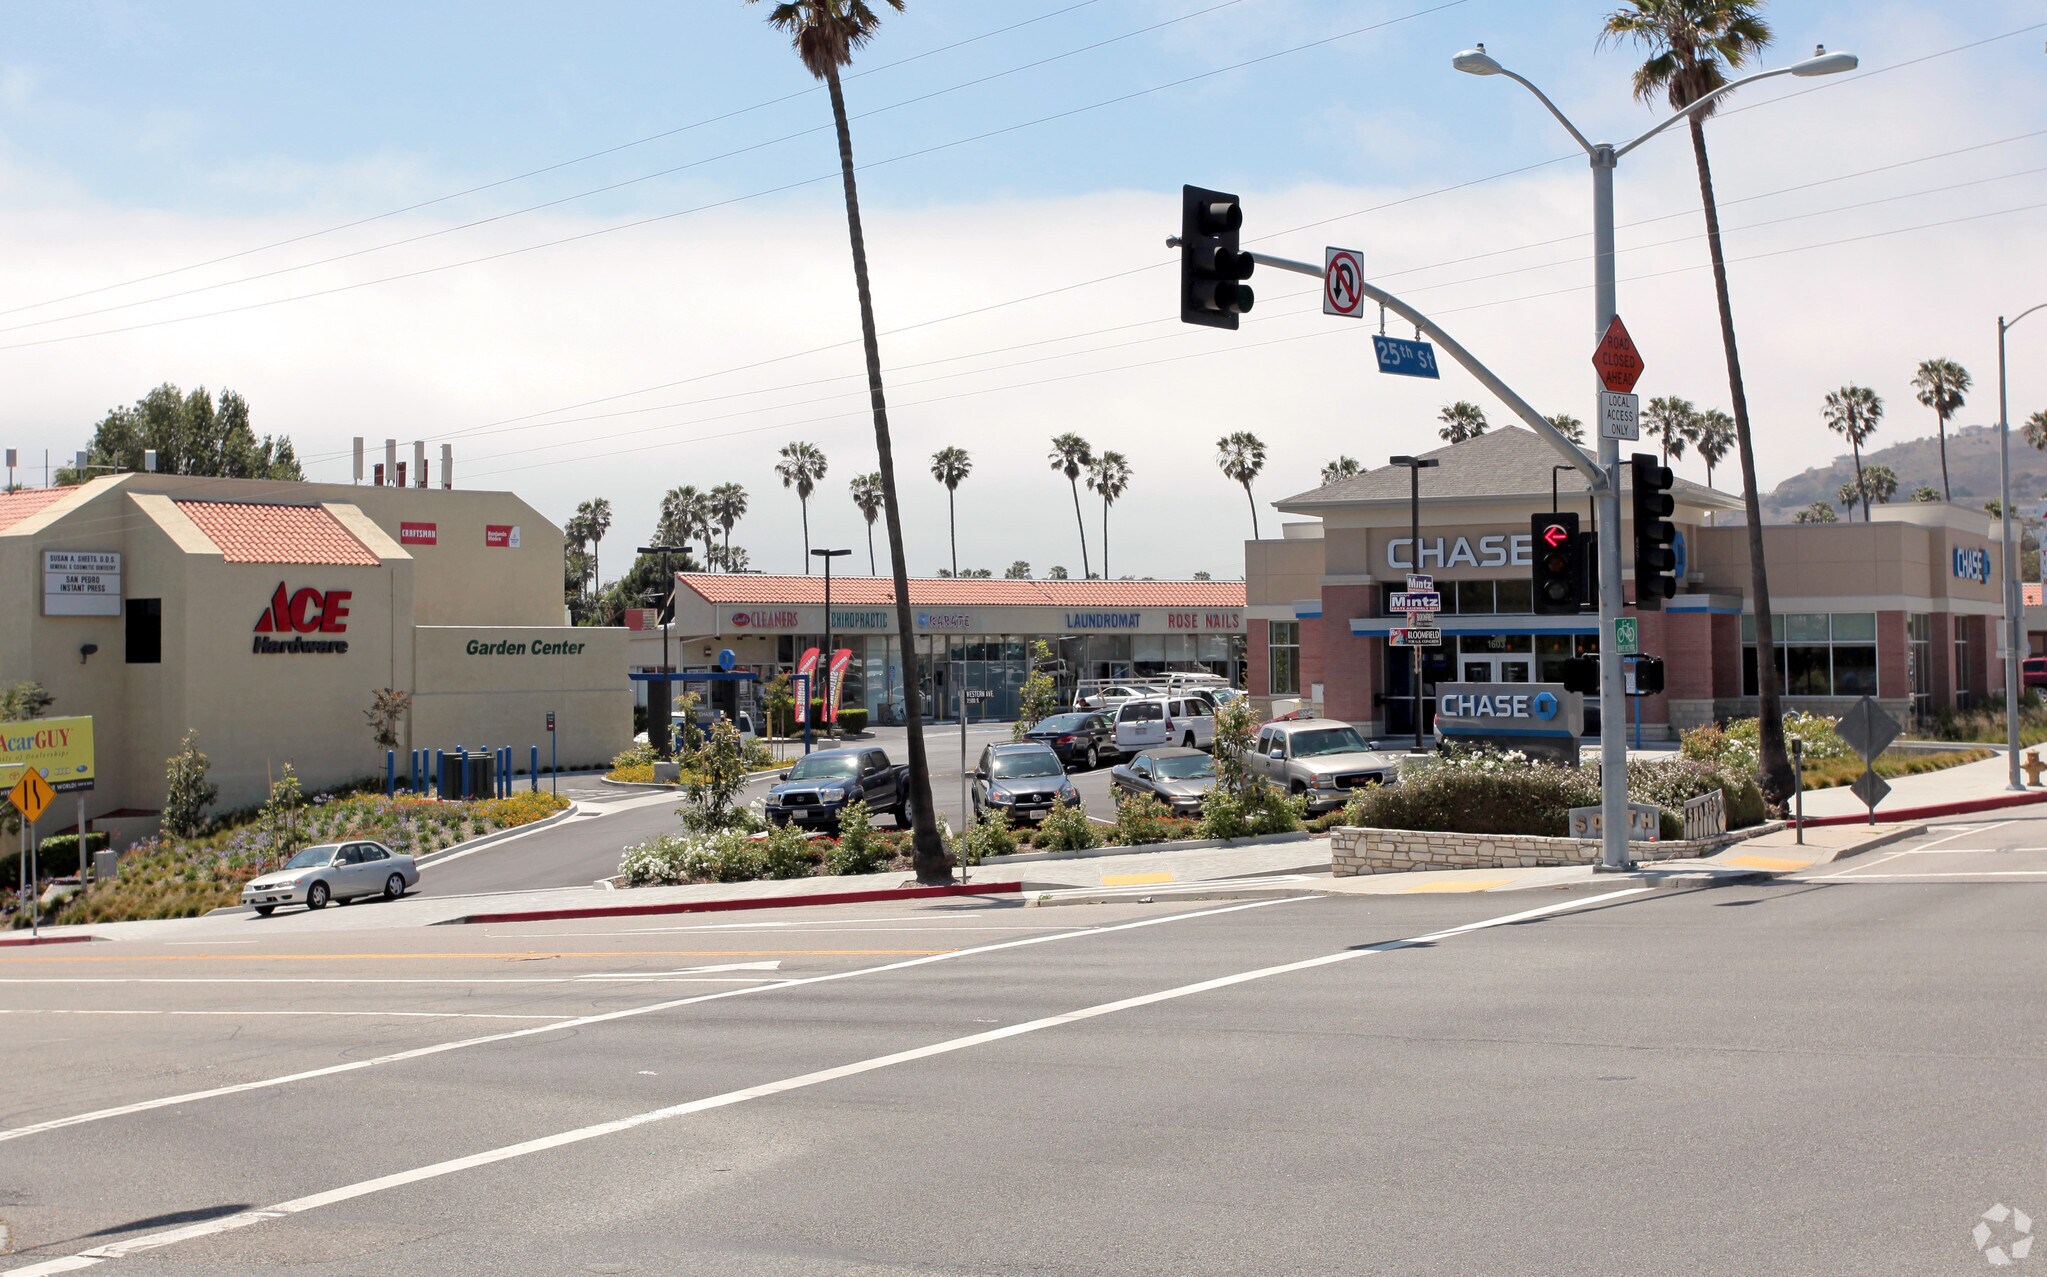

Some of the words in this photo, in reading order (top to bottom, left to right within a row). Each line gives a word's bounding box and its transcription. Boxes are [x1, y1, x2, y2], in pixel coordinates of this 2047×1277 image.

[1608, 336, 1629, 350] ROAD
[1378, 341, 1413, 365] 25th
[1417, 350, 1435, 369] St
[1603, 352, 1635, 369] CLOSED
[1606, 371, 1634, 386] AHEAD
[1608, 395, 1630, 408] LOCAL
[1606, 409, 1633, 422] ACCESS
[1611, 423, 1629, 435] ONLY
[401, 529, 436, 538] CRAFTSMAN
[1387, 534, 1532, 569] CHASE
[1957, 547, 1983, 580] CHASE
[66, 575, 78, 583] SAN
[81, 576, 100, 584] PEDRO
[1408, 578, 1433, 589] Mintz
[60, 584, 85, 592] INSTANT
[253, 580, 352, 633] ACE
[1391, 596, 1439, 607] Mintz
[751, 611, 798, 627] CLEANERS
[831, 612, 888, 628] CHIROPRACTIC
[929, 615, 970, 627] KARATE
[1066, 613, 1141, 628] LAUNDROMAT
[1168, 614, 1198, 628] ROSE
[1205, 614, 1239, 628] NAILS
[1407, 631, 1440, 639] BLOOMFIELD
[253, 636, 349, 654] Hardware
[466, 639, 527, 655] Garden
[531, 639, 586, 655] Center
[1488, 640, 1506, 649] 1603
[1441, 694, 1529, 717] CHASE
[26, 750, 69, 760] Dealerships
[1575, 809, 1654, 834] SOTH
